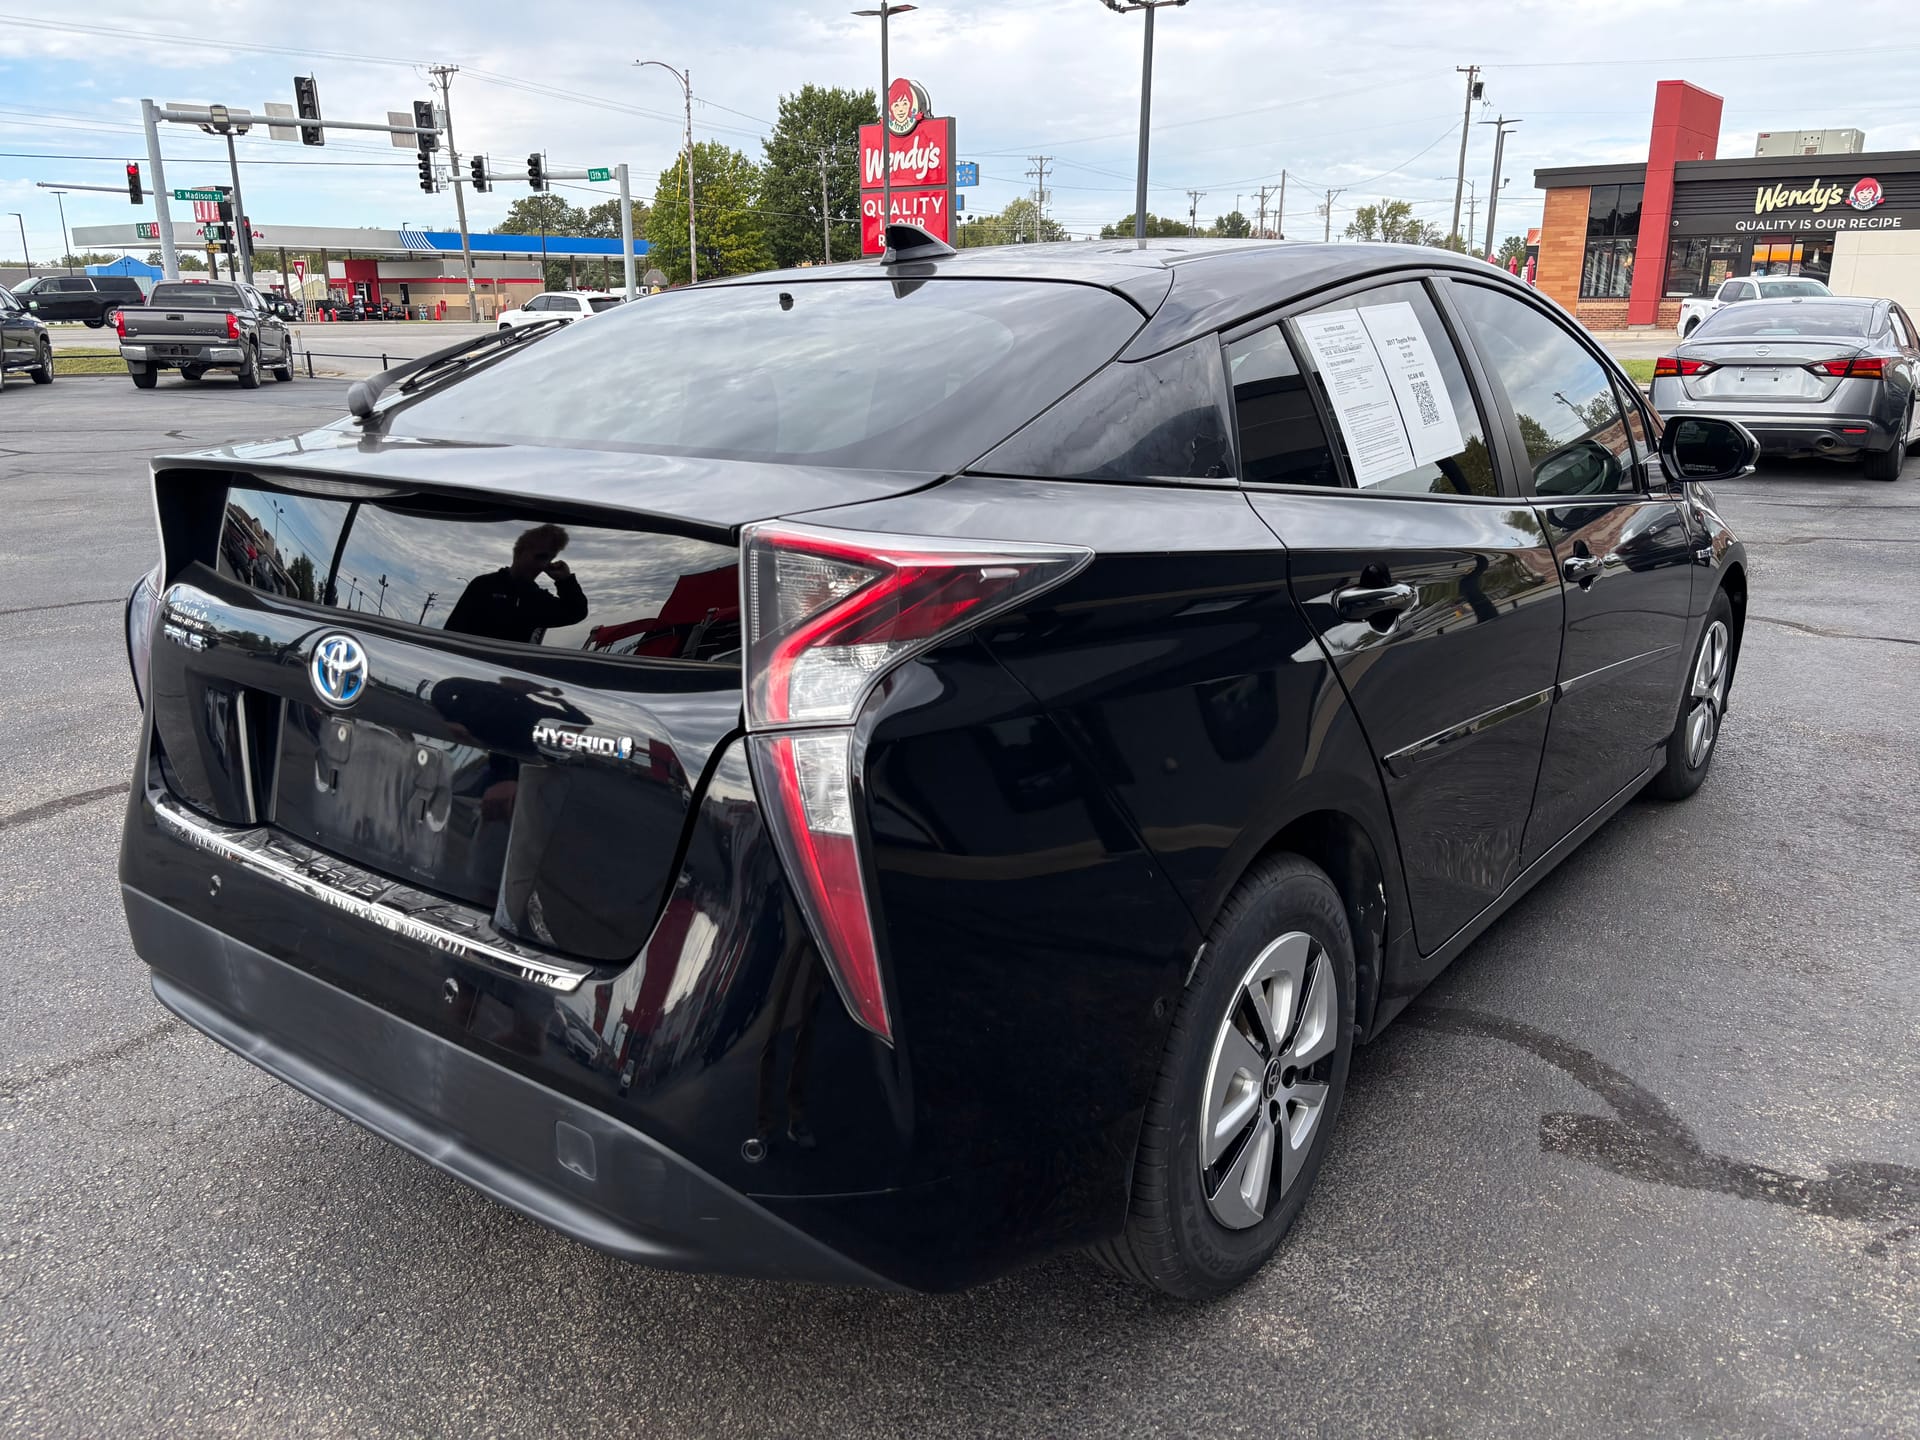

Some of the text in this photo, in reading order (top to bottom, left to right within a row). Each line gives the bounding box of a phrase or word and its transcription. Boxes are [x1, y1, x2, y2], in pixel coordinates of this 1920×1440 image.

[185, 191, 212, 200] Madison
[1755, 178, 1844, 215] Wendy's
[864, 196, 943, 217] QUALITY
[1735, 217, 1902, 231] QUALITY IS OUR RECIPE
[532, 725, 617, 757] HYBRID
